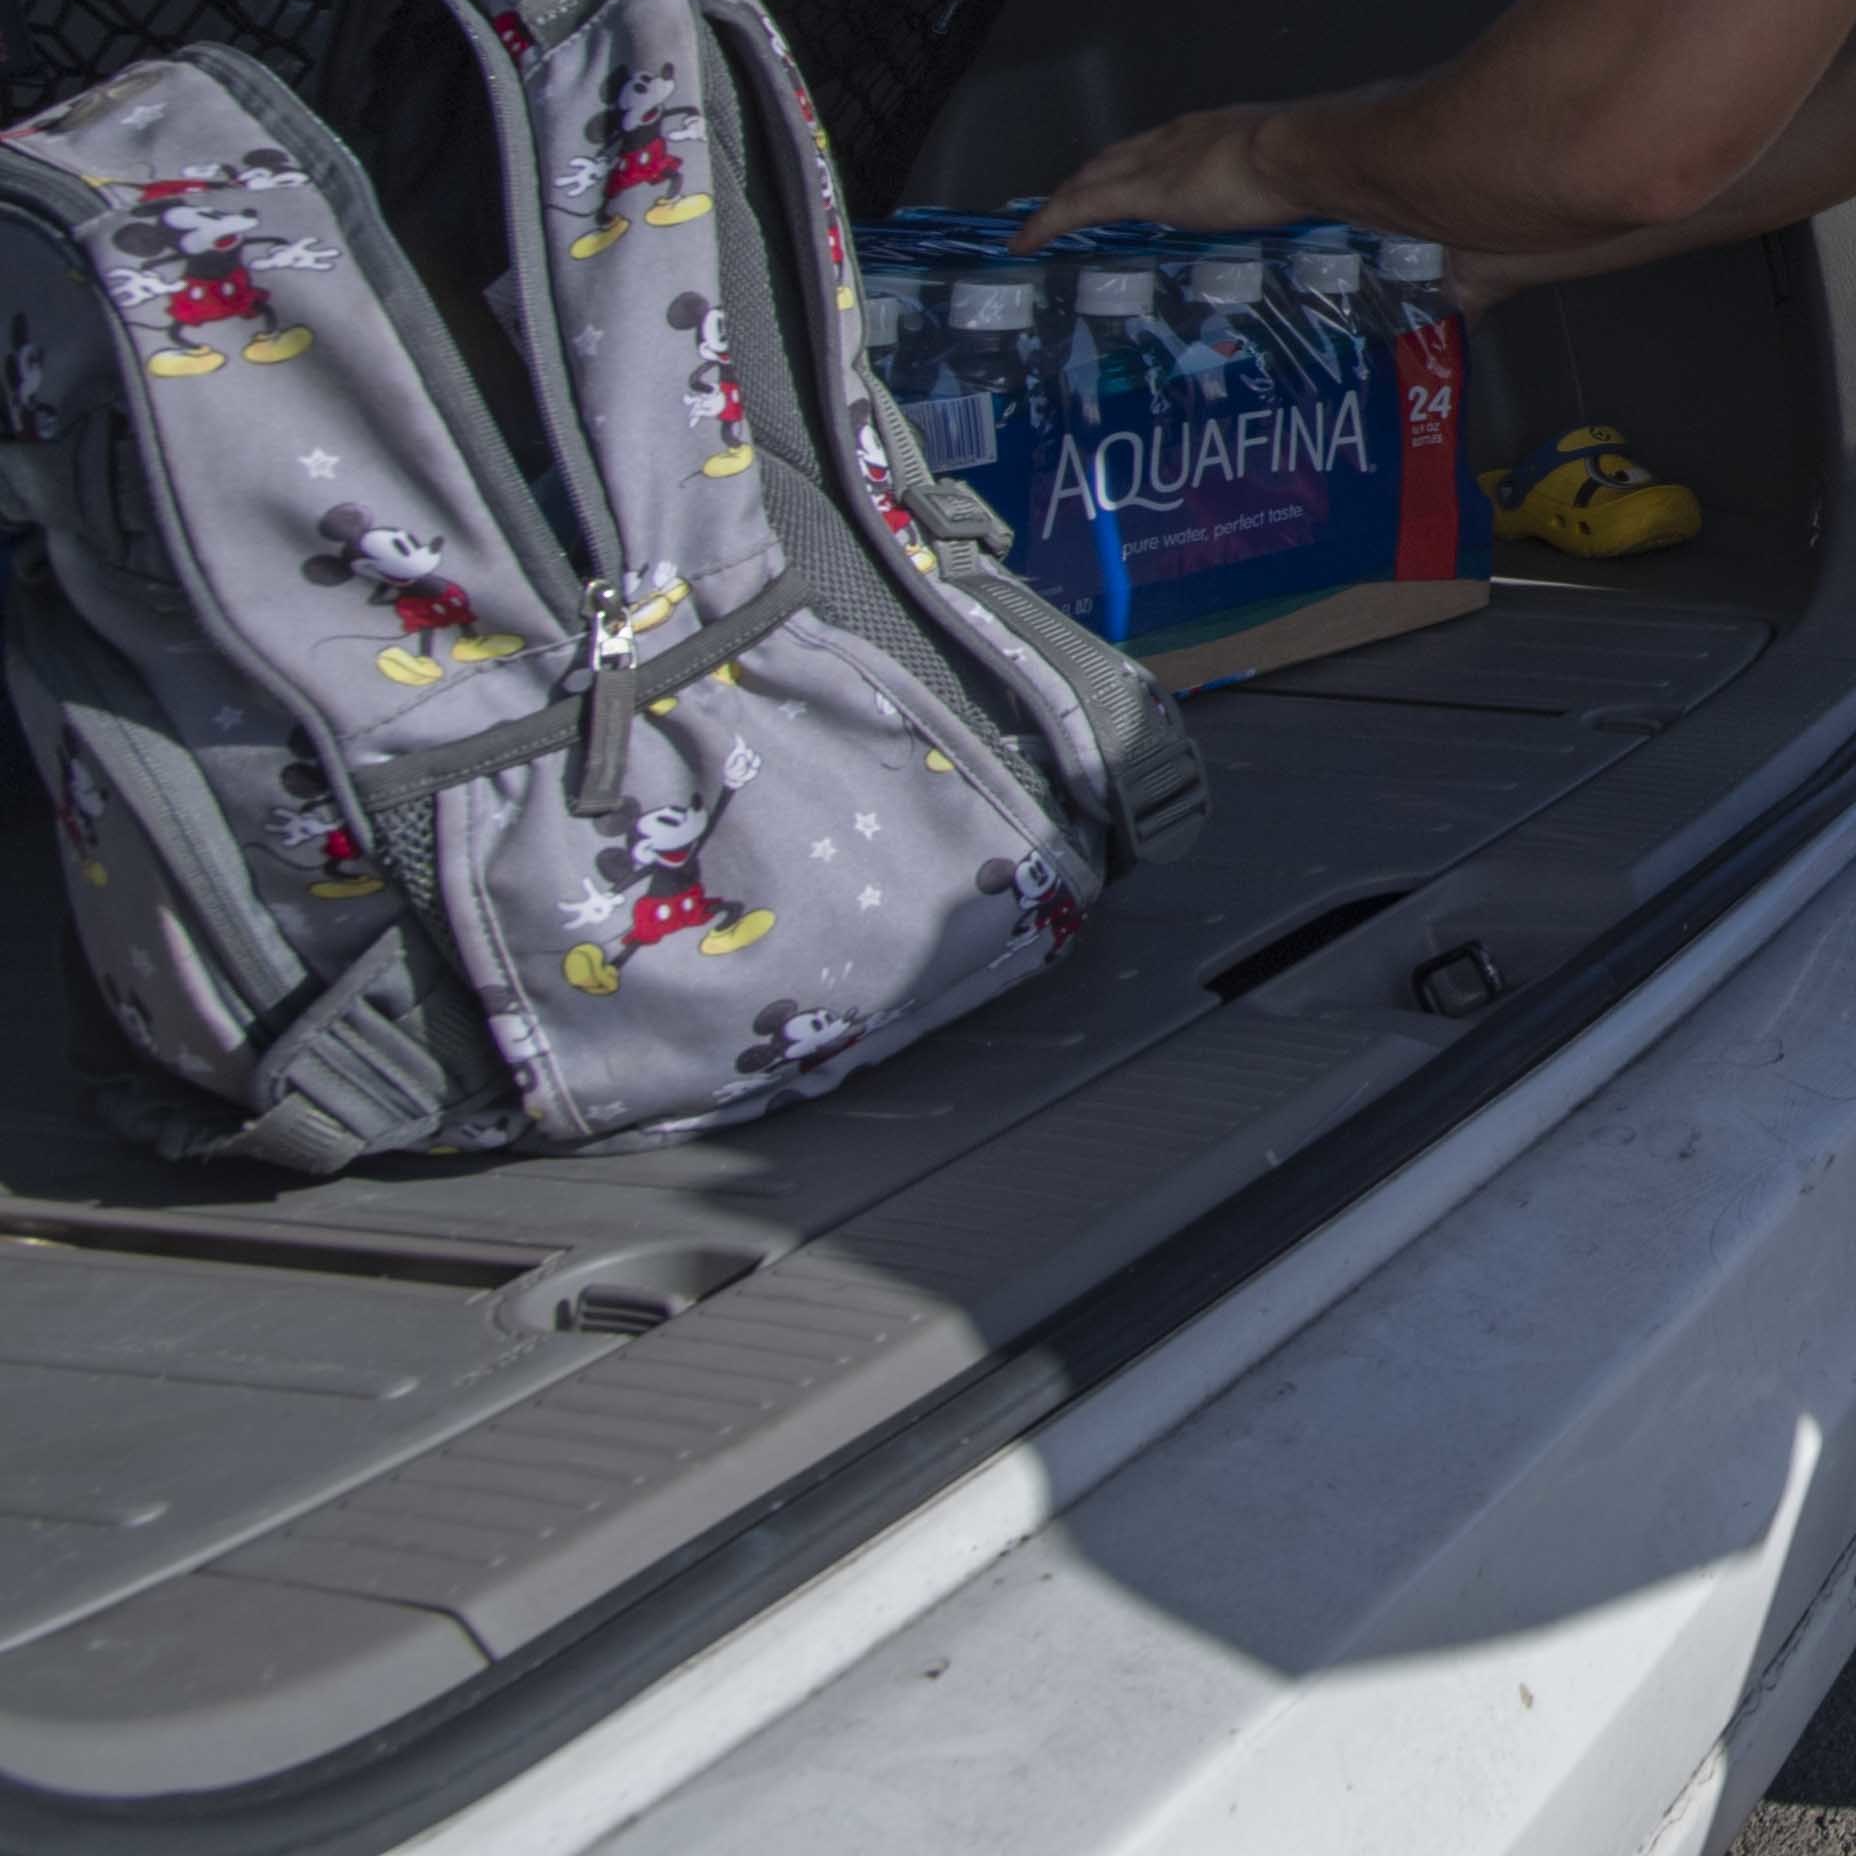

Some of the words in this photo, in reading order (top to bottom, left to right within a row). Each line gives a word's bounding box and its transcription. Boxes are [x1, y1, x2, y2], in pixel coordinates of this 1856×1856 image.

[1408, 384, 1453, 423] 24
[1042, 389, 1369, 541] AQUAFINA
[1121, 535, 1160, 562] pure
[1163, 527, 1209, 548] water,
[1213, 512, 1265, 540] perfect
[1268, 503, 1305, 524] taste
